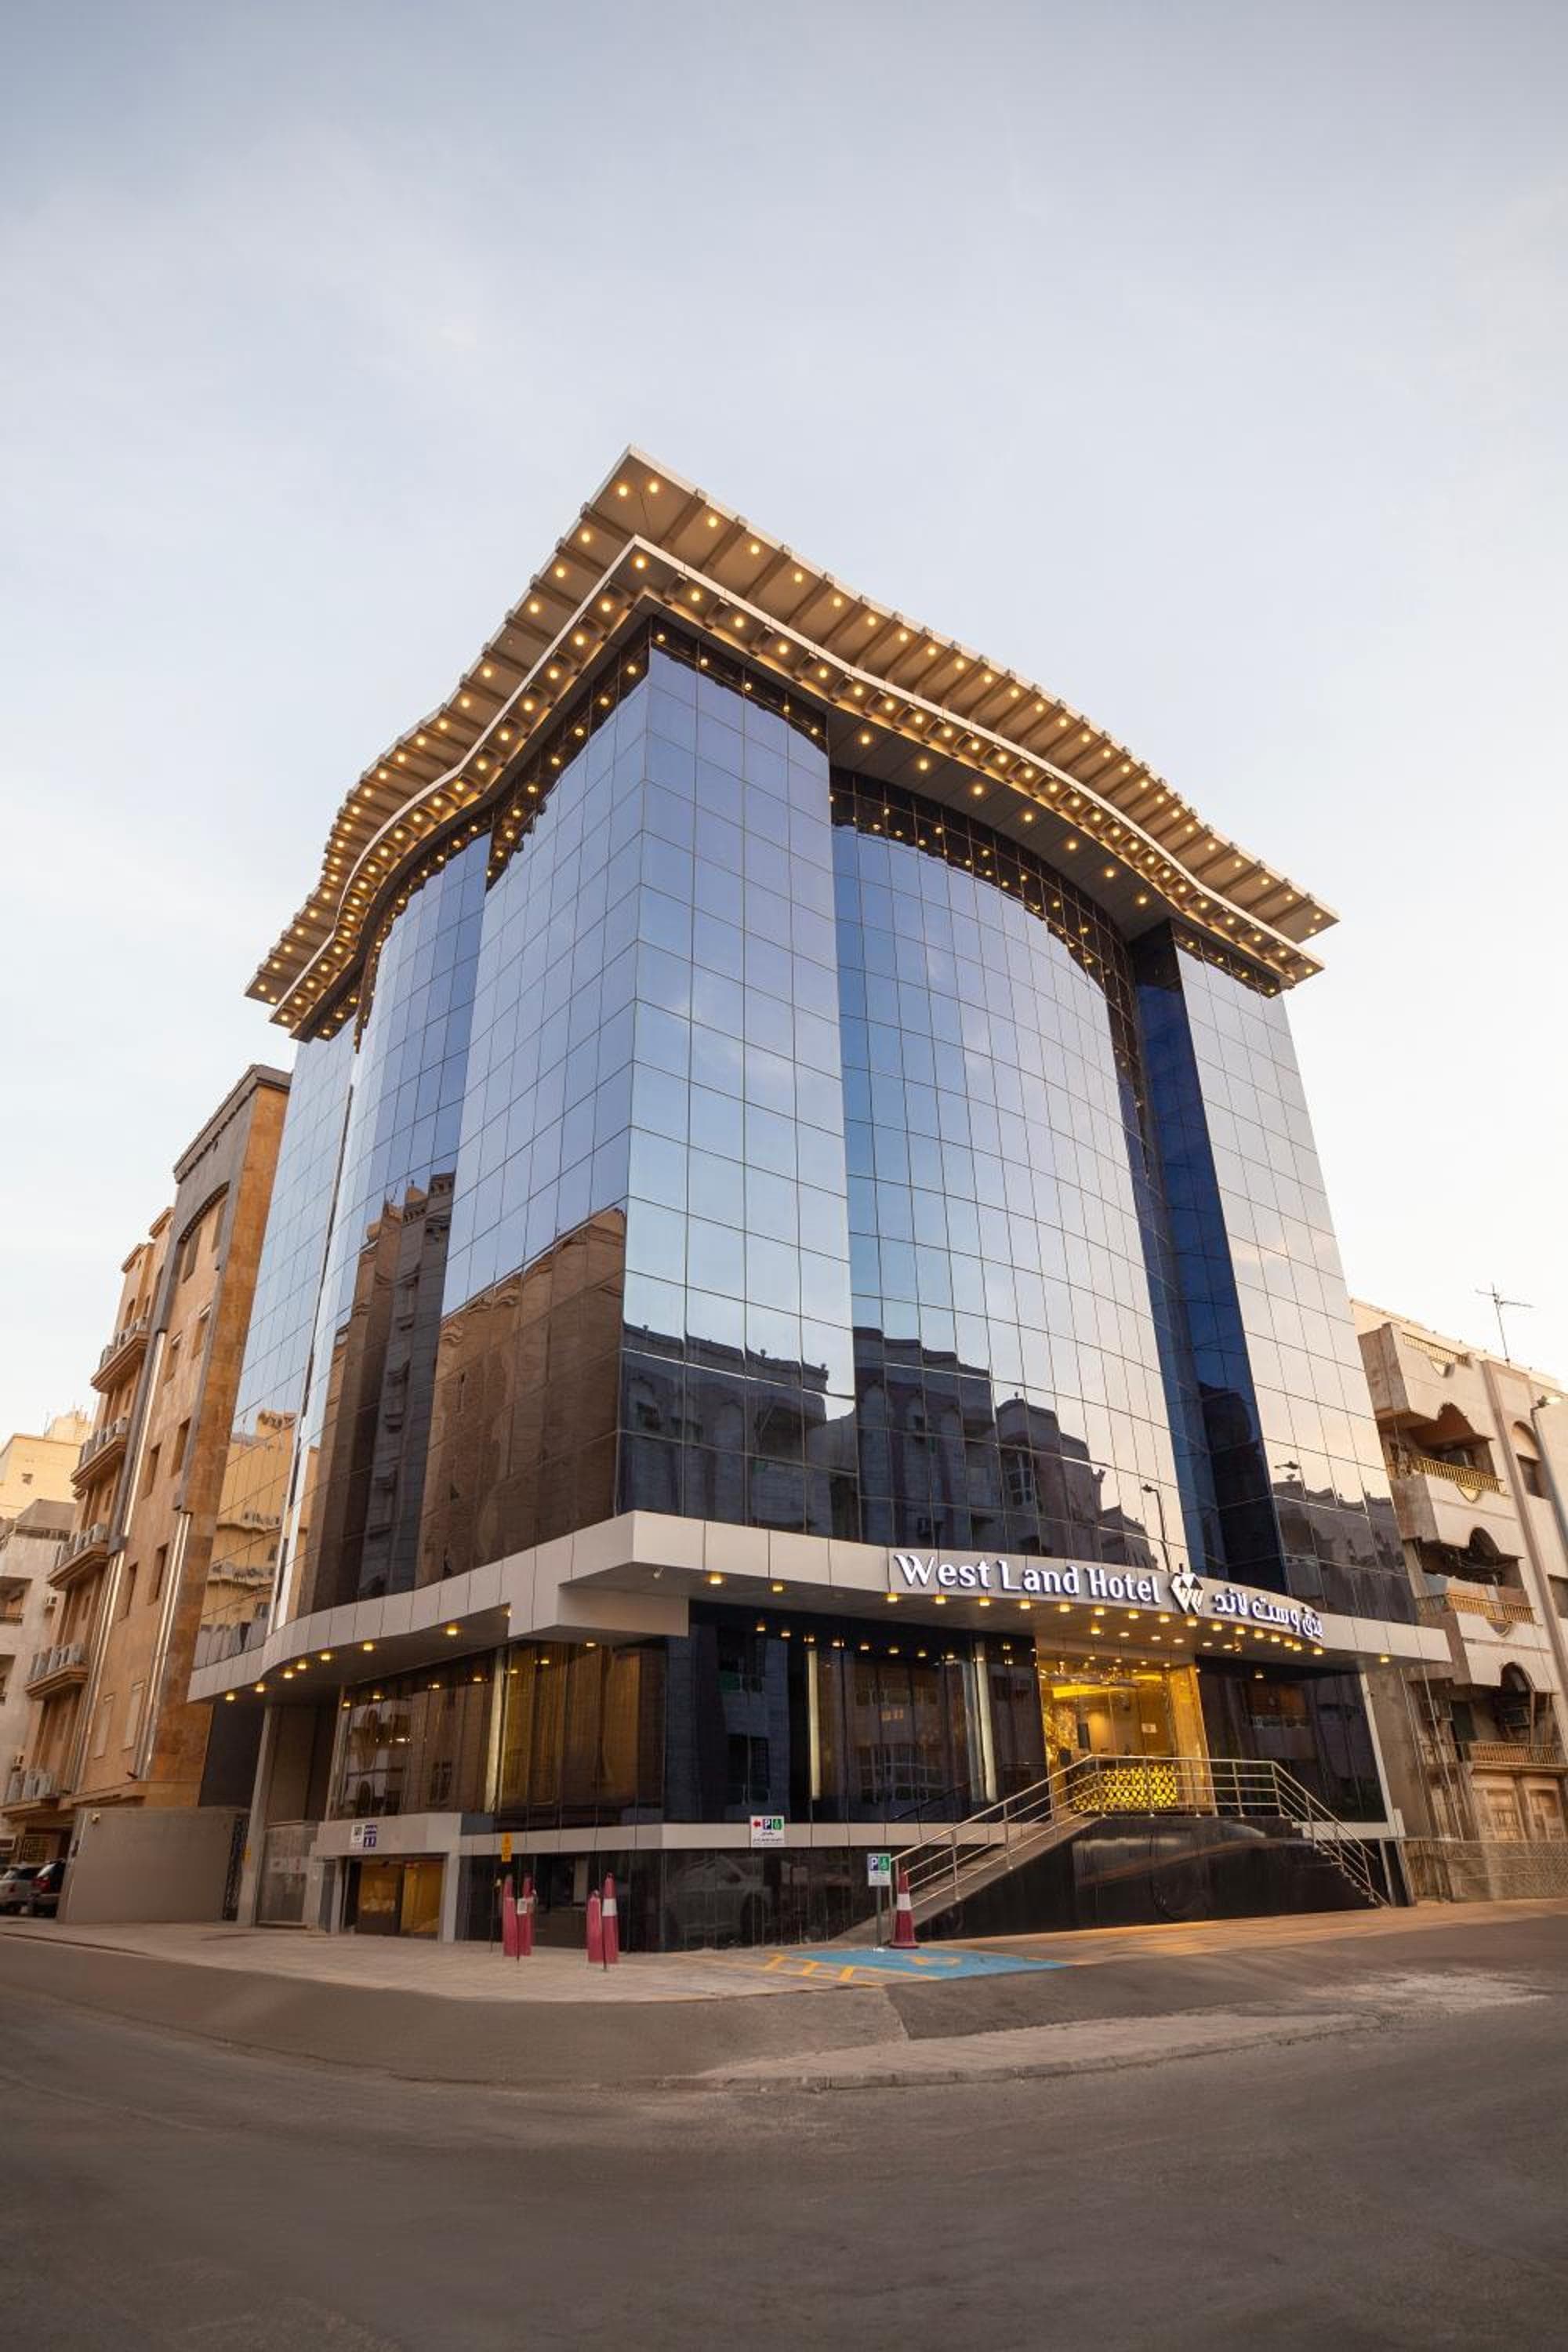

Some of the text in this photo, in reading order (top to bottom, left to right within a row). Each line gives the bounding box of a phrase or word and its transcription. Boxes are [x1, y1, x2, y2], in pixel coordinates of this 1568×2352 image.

[895, 1555, 1163, 1604] West Land Hotel
[1214, 1588, 1324, 1638] فندق وست لاند
[871, 1857, 878, 1870] P
